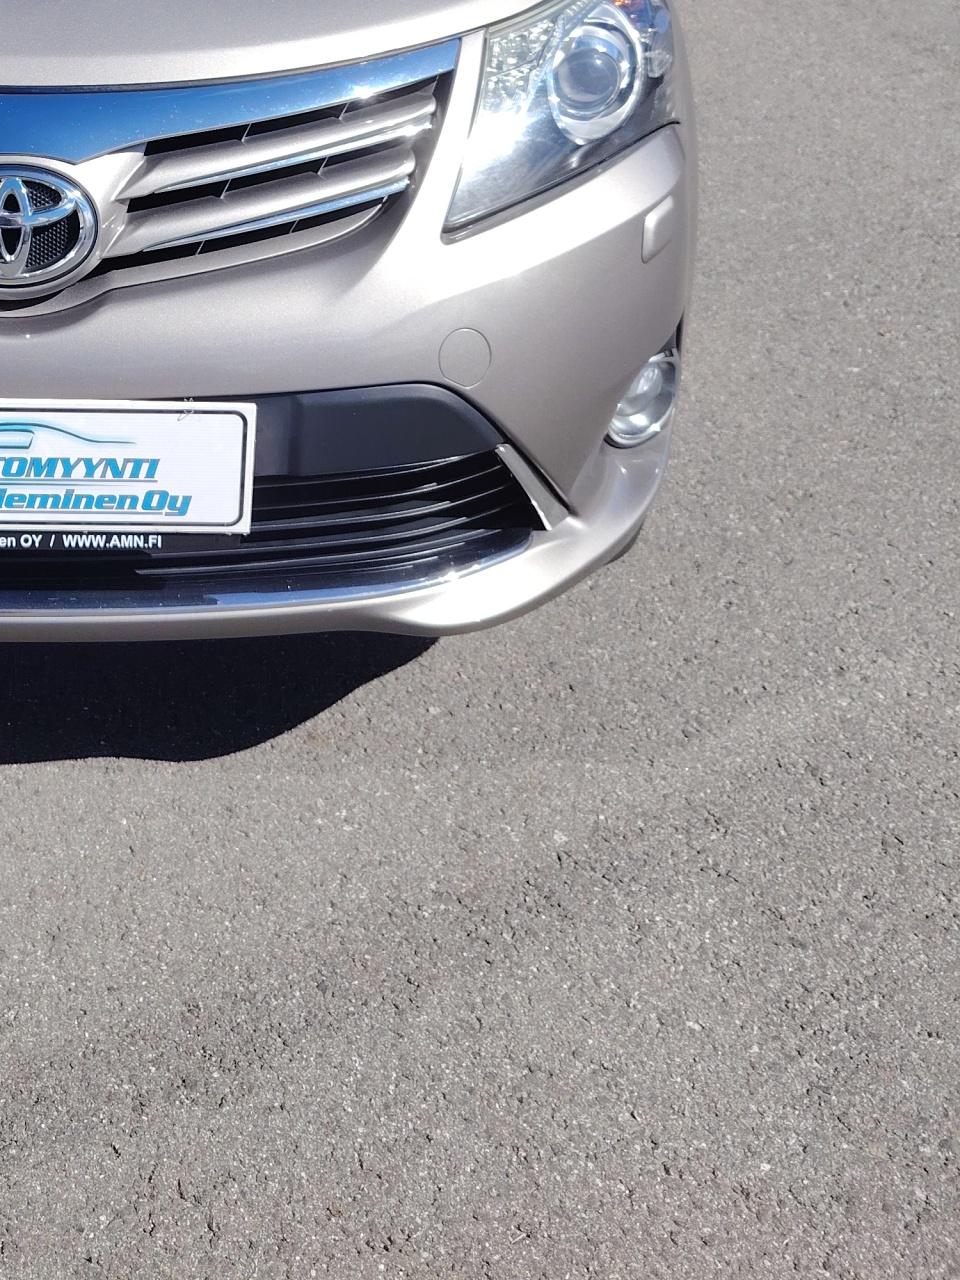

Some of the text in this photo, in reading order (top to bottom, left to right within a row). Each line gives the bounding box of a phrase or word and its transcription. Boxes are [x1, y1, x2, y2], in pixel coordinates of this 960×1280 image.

[20, 534, 43, 548] OY
[50, 534, 56, 548] /
[62, 534, 163, 549] WWW.AMN.FI
